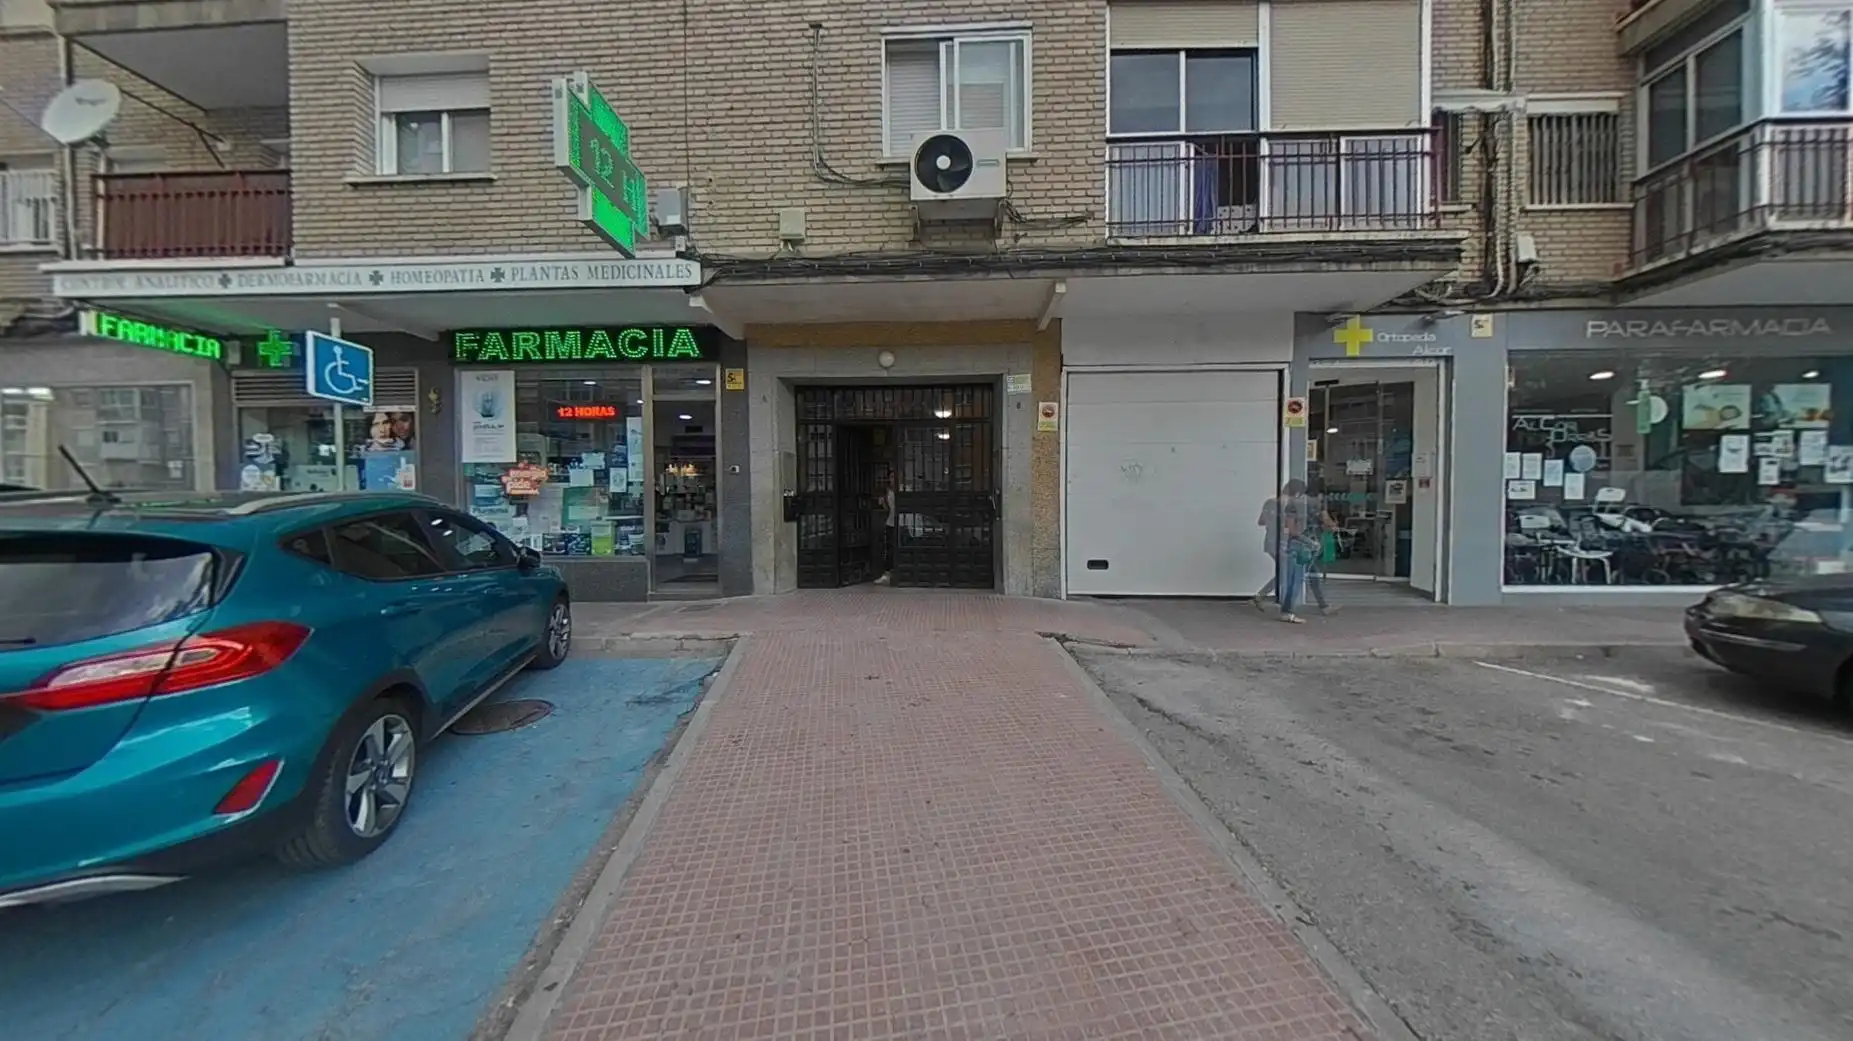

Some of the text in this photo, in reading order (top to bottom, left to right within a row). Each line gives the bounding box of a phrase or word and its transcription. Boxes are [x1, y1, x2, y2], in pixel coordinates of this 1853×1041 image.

[238, 271, 362, 287] DERMOFARMACIA
[390, 269, 485, 285] HOMEOPATIA
[511, 265, 579, 281] PLANTAS
[587, 263, 693, 280] MEDICINALES
[101, 312, 220, 359] FARMACIA
[455, 328, 701, 361] FARMACIA
[557, 405, 616, 417] 12 HORAS
